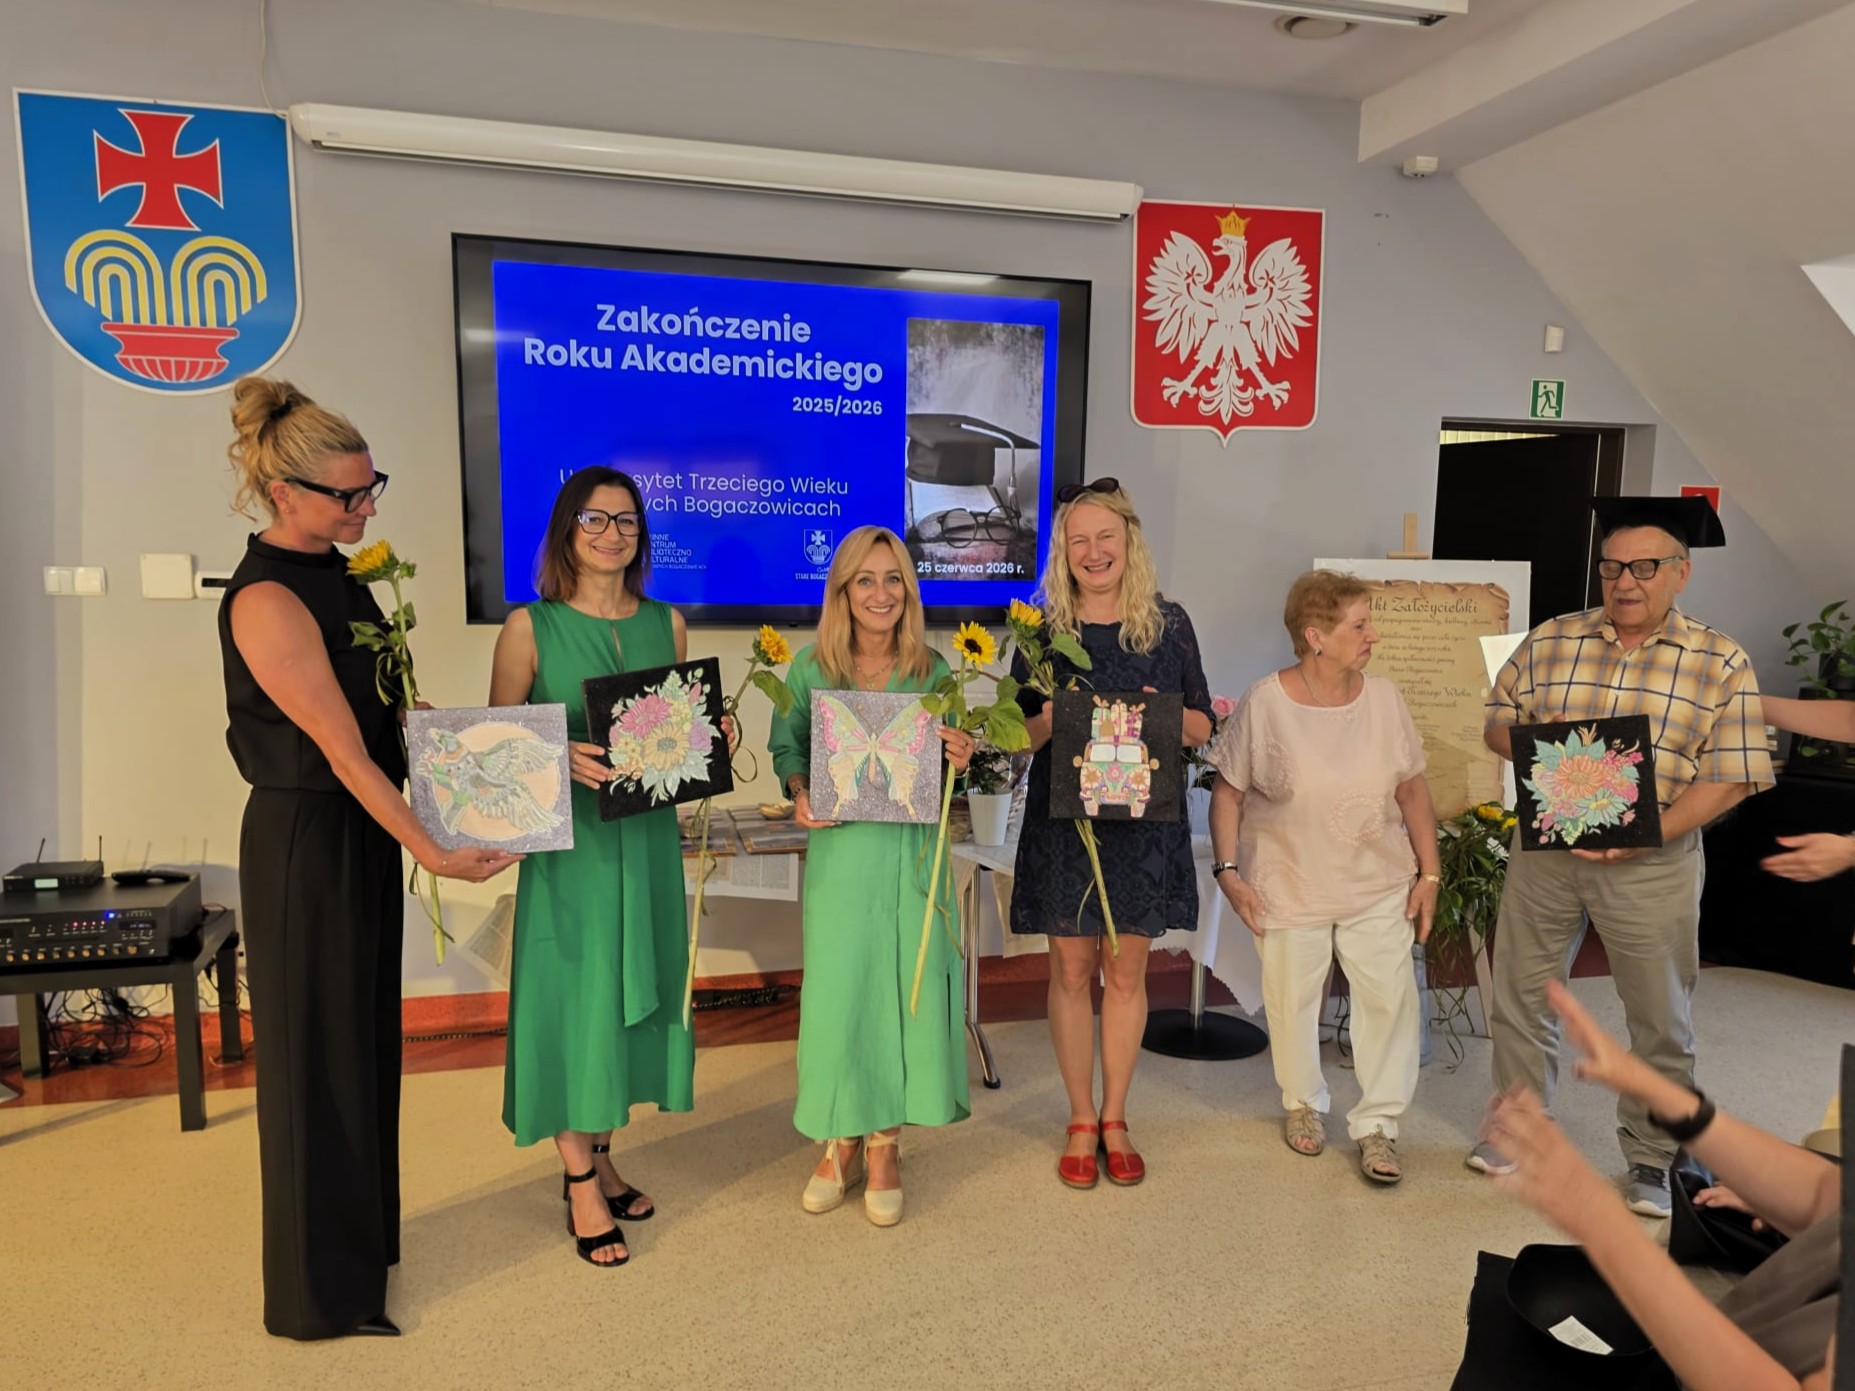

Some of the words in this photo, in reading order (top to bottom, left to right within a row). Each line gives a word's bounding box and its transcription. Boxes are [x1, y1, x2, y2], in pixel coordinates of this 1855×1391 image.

[597, 304, 811, 343] Zakończenie
[524, 337, 612, 369] Roku
[620, 344, 883, 391] Akademickiego
[792, 395, 883, 416] 2025/2026
[689, 473, 785, 497] Trzeciego
[790, 476, 848, 494] Wieku
[684, 496, 841, 519] Bogaczowicach
[917, 562, 932, 573] 25
[934, 563, 983, 573] czerwca
[986, 562, 1014, 574] 2026
[1016, 564, 1025, 574] r.
[1391, 596, 1478, 619] Założycielski
